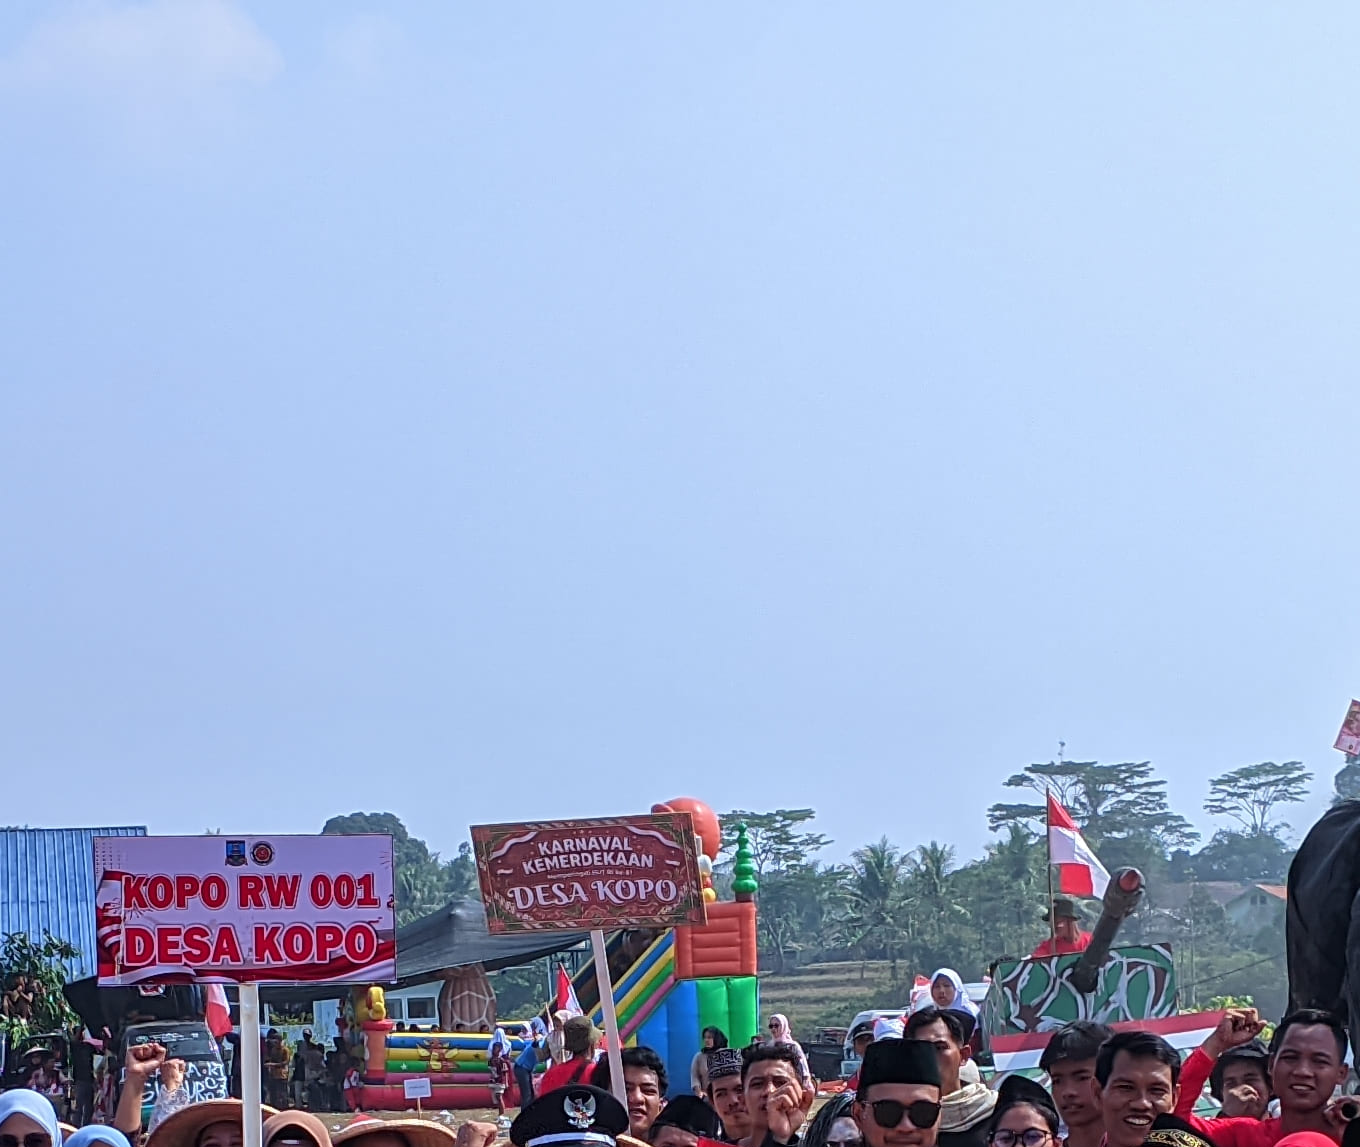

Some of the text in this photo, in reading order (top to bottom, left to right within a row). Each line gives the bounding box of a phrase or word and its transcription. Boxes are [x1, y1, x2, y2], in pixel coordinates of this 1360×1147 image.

[538, 836, 633, 855] KARNAVAL
[522, 852, 653, 875] KEMERDEKAAN
[123, 872, 380, 910] KOPO RW 001
[507, 879, 677, 910] DESA KOPO
[124, 922, 377, 965] DESA KOPO
